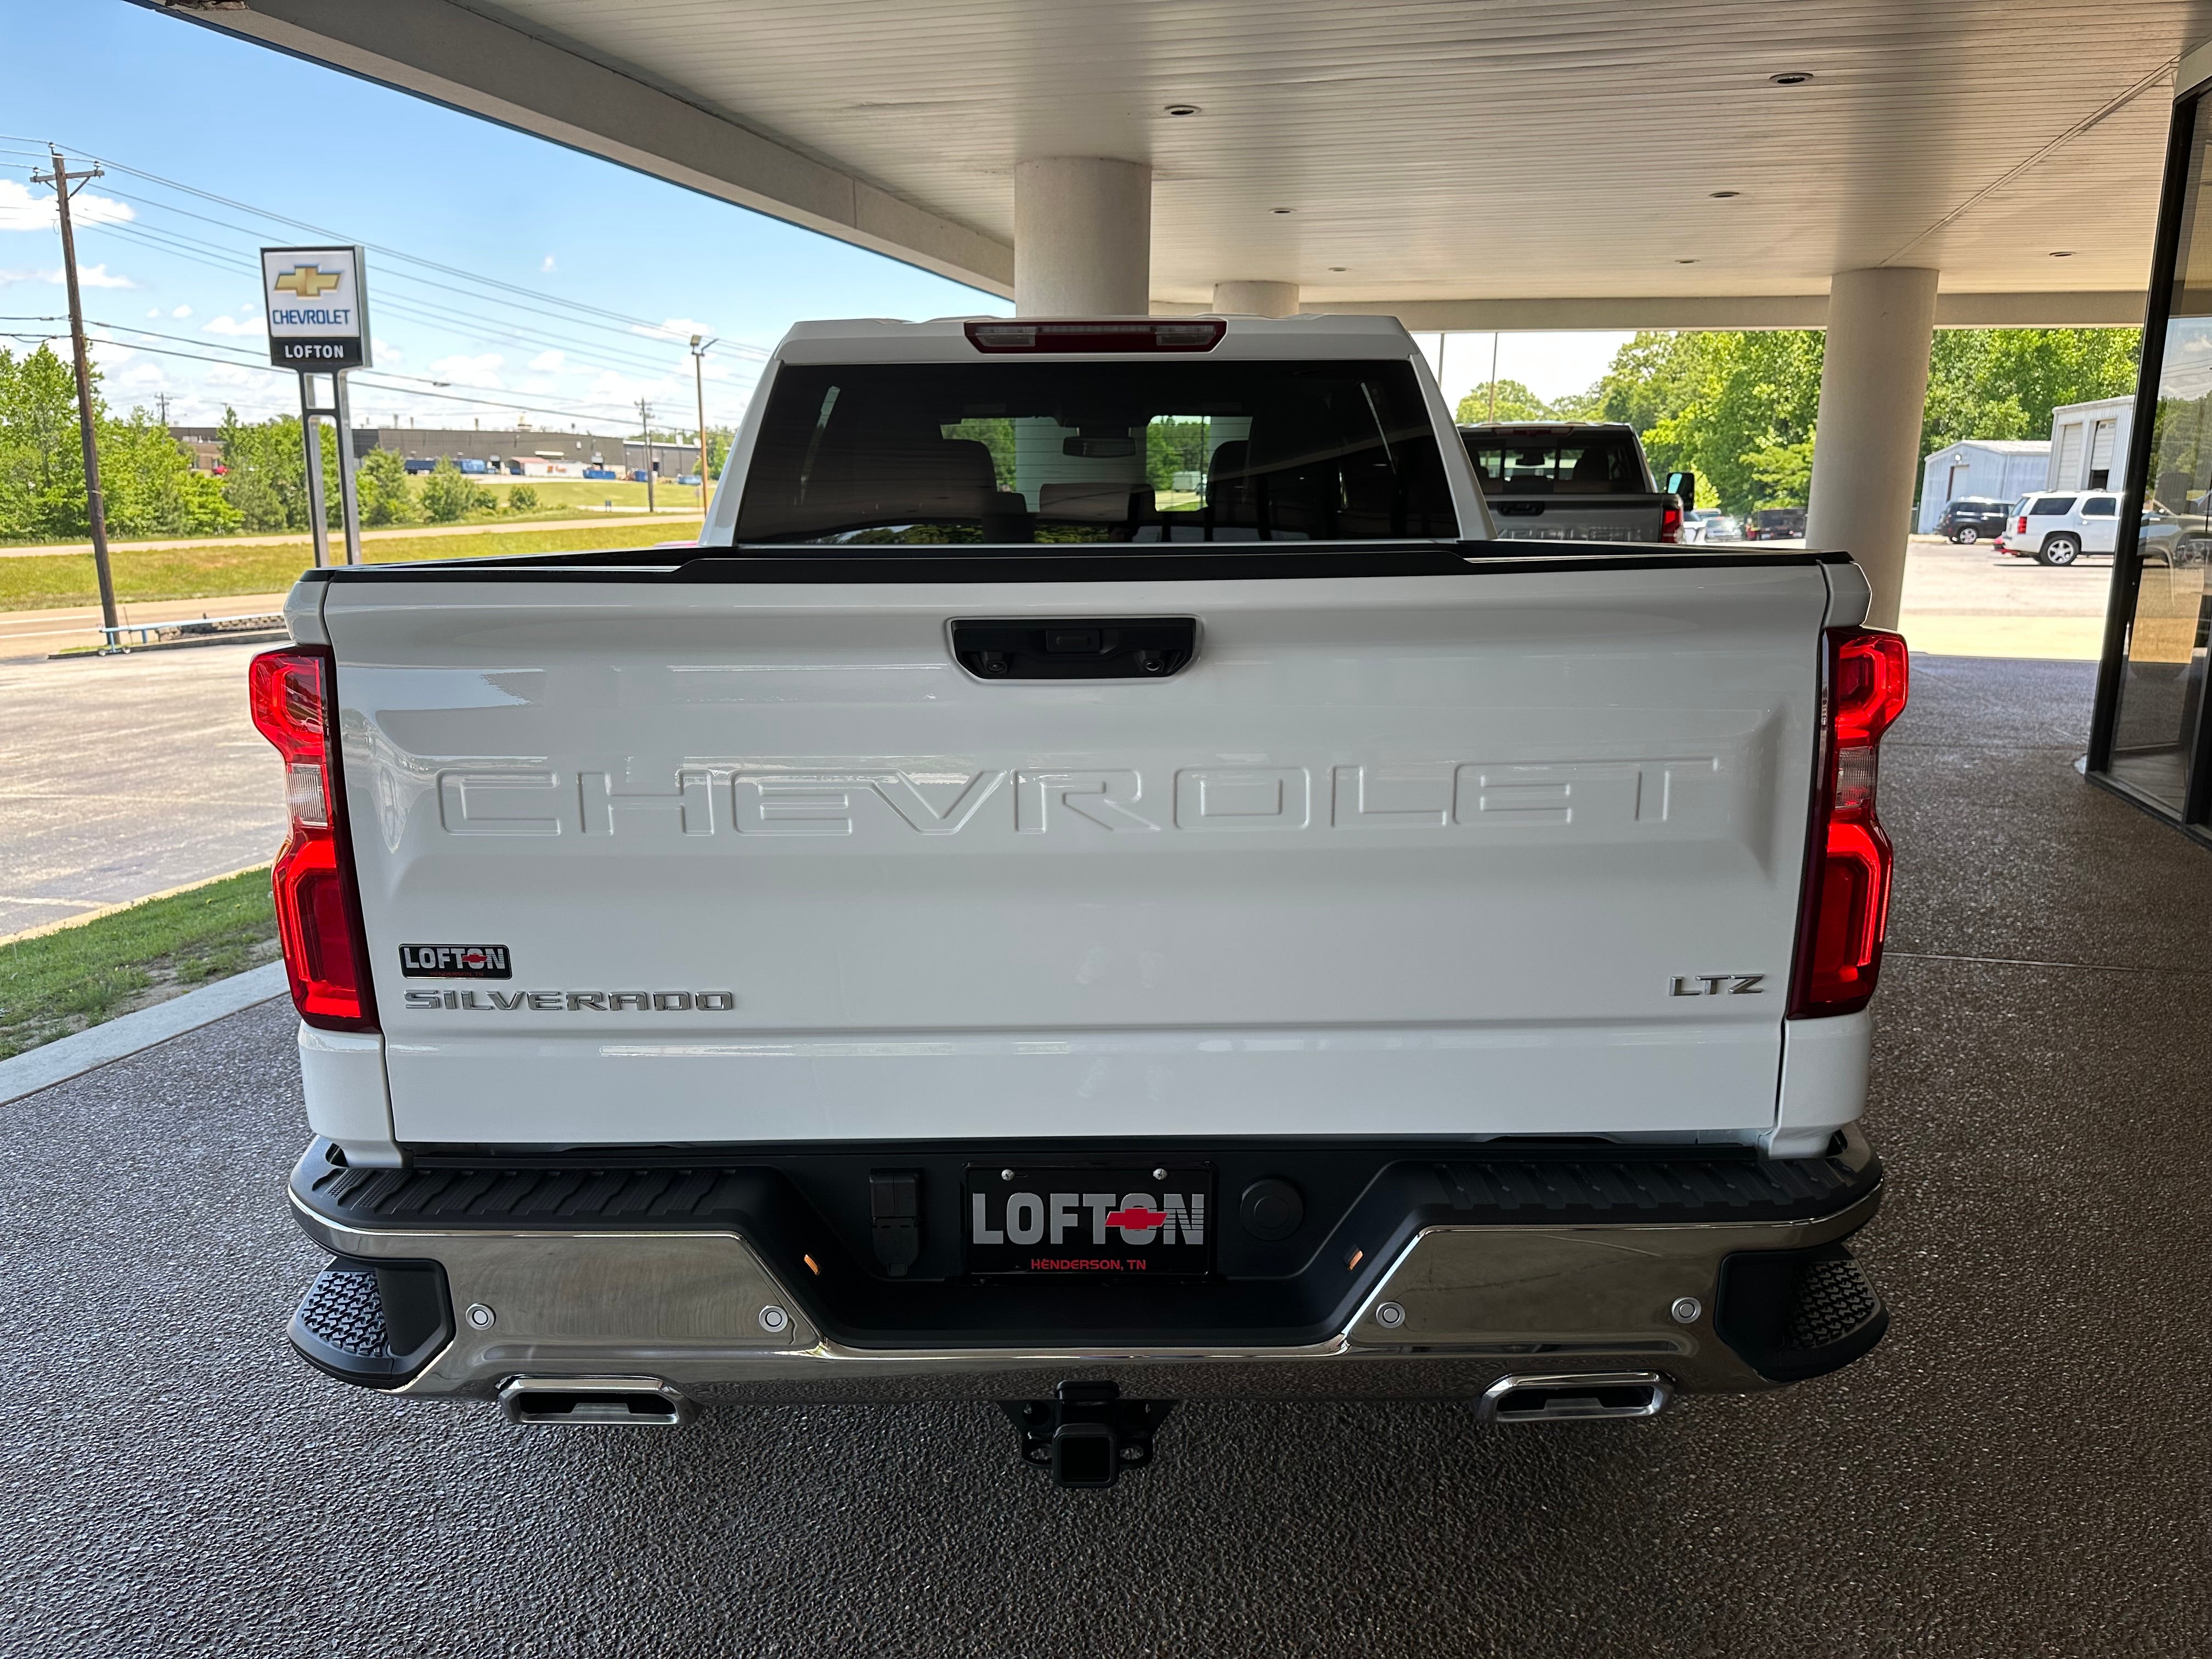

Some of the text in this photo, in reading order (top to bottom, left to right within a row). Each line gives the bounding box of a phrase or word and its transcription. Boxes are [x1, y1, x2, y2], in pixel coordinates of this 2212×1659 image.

[273, 309, 351, 325] CHEVROLET
[285, 345, 344, 358] LOFTON
[437, 757, 1719, 836] CHEVROLET
[404, 947, 505, 969] LOFTON
[1669, 974, 1764, 996] LTZ
[404, 989, 733, 1012] SILVERADO
[973, 1192, 1204, 1245] LOFTON
[1031, 1259, 1146, 1271] HENDERSON, TN
